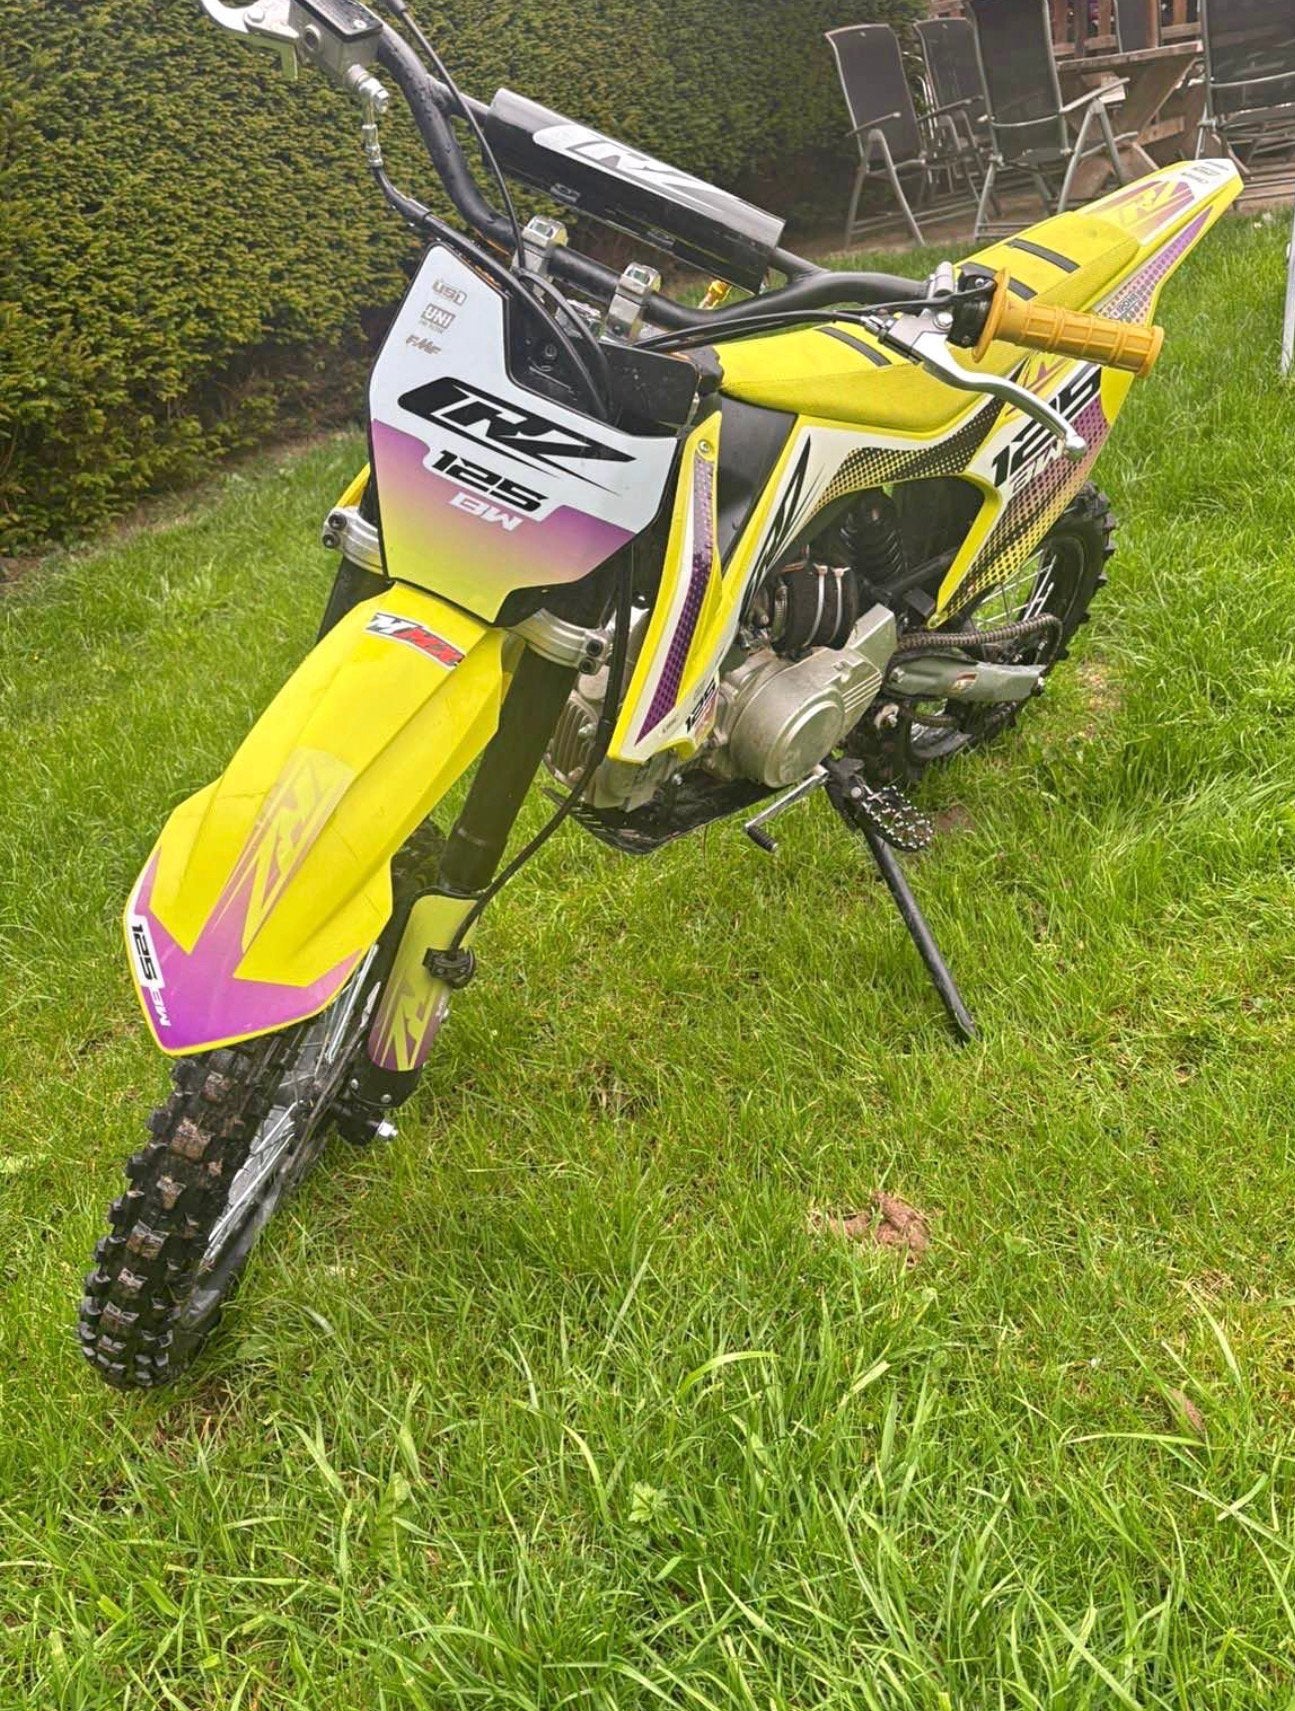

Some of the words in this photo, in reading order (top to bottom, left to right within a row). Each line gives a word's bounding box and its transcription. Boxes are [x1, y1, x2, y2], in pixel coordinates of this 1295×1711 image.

[423, 304, 454, 329] UNI
[432, 450, 549, 512] 125
[449, 492, 523, 531] BW
[132, 924, 158, 980] 125
